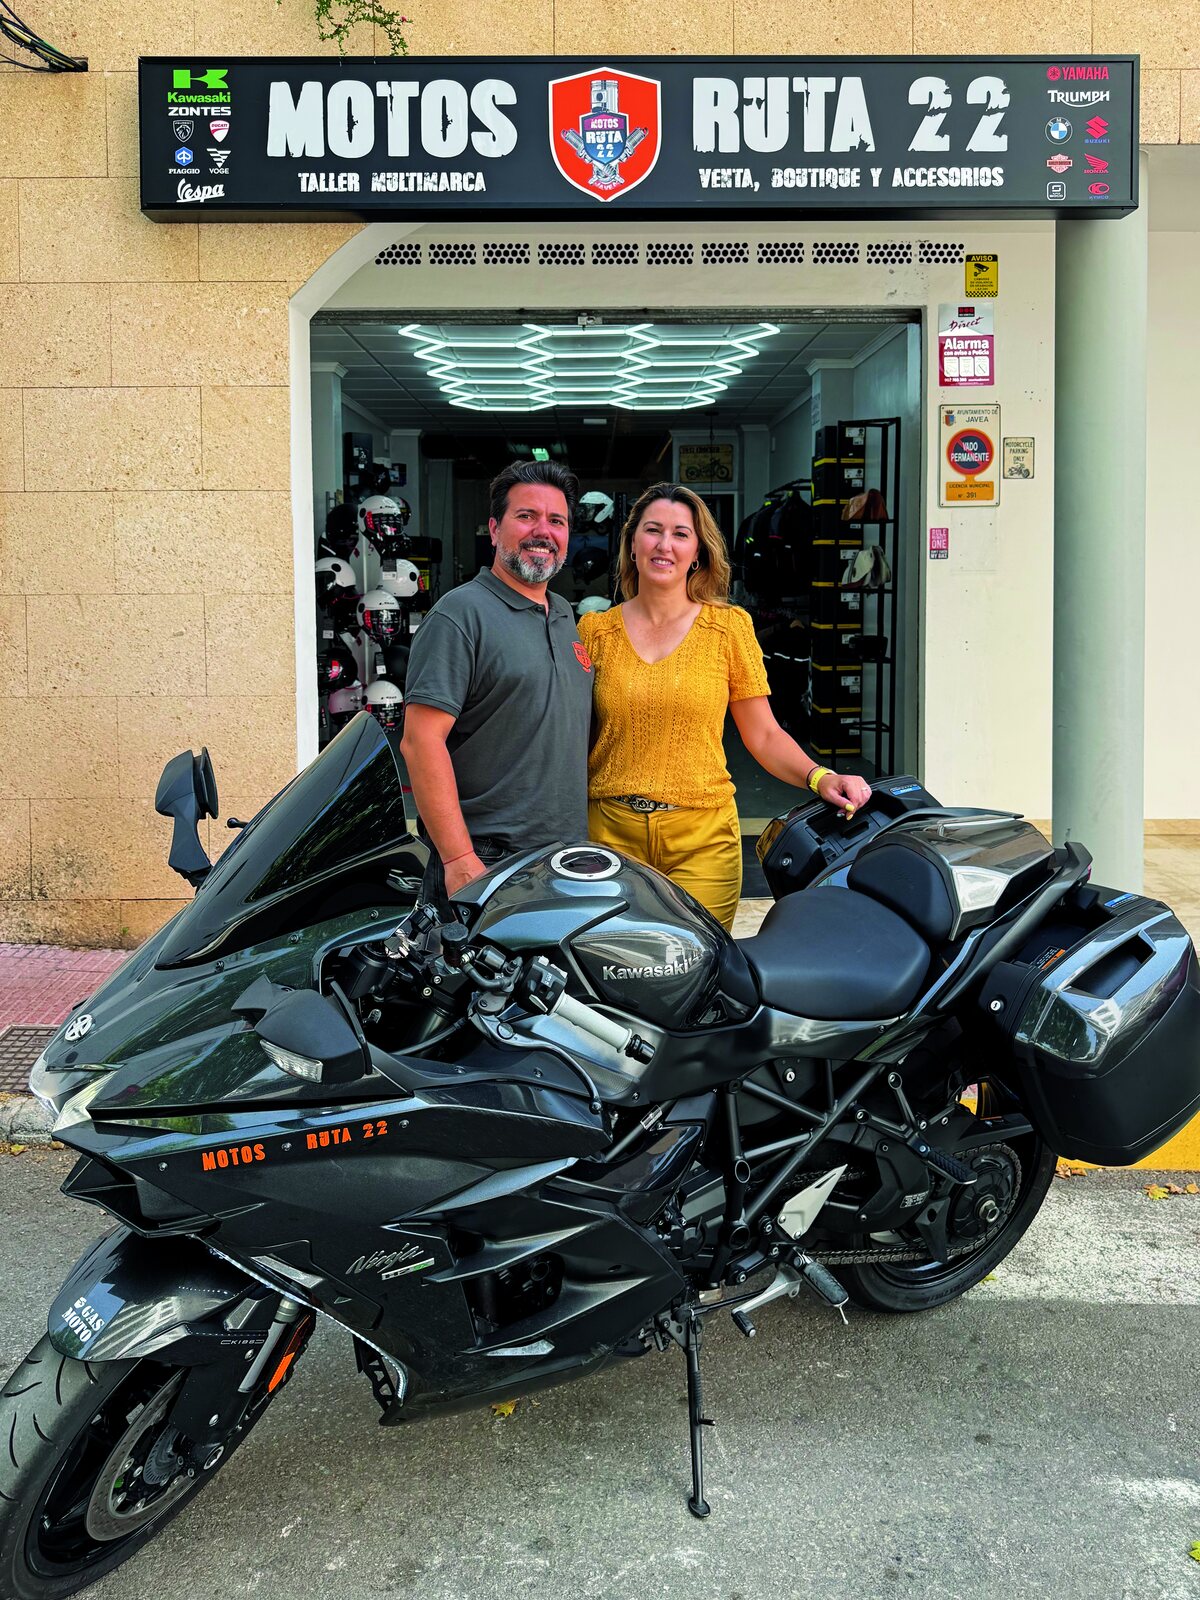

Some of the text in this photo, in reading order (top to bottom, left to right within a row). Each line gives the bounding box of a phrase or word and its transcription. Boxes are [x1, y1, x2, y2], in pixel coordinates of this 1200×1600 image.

[1062, 66, 1109, 80] YAMAHA
[167, 92, 231, 103] Kawasaki
[1047, 89, 1110, 107] TRIUMPH
[168, 106, 231, 116] ZONTES
[693, 76, 1010, 153] RUTA 22
[266, 79, 518, 158] MOTOS
[591, 118, 618, 128] MOTOS
[586, 131, 623, 144] RUTA
[596, 144, 614, 158] 22
[208, 167, 229, 175] VOGE
[297, 171, 487, 193] TALLER MULTIMARCA
[698, 167, 1004, 192] VENTA, BOUTIQUE Y ACCESORIOS
[176, 178, 225, 203] Vespa
[944, 338, 989, 349] Alarma
[962, 441, 979, 451] VADO
[950, 452, 990, 463] PERMANENTE
[931, 539, 947, 549] ONE
[602, 959, 689, 980] Kawasaki
[202, 1120, 388, 1171] MOTOS RUTA 22
[61, 1306, 92, 1342] MOTO
[81, 1305, 105, 1332] GAS
